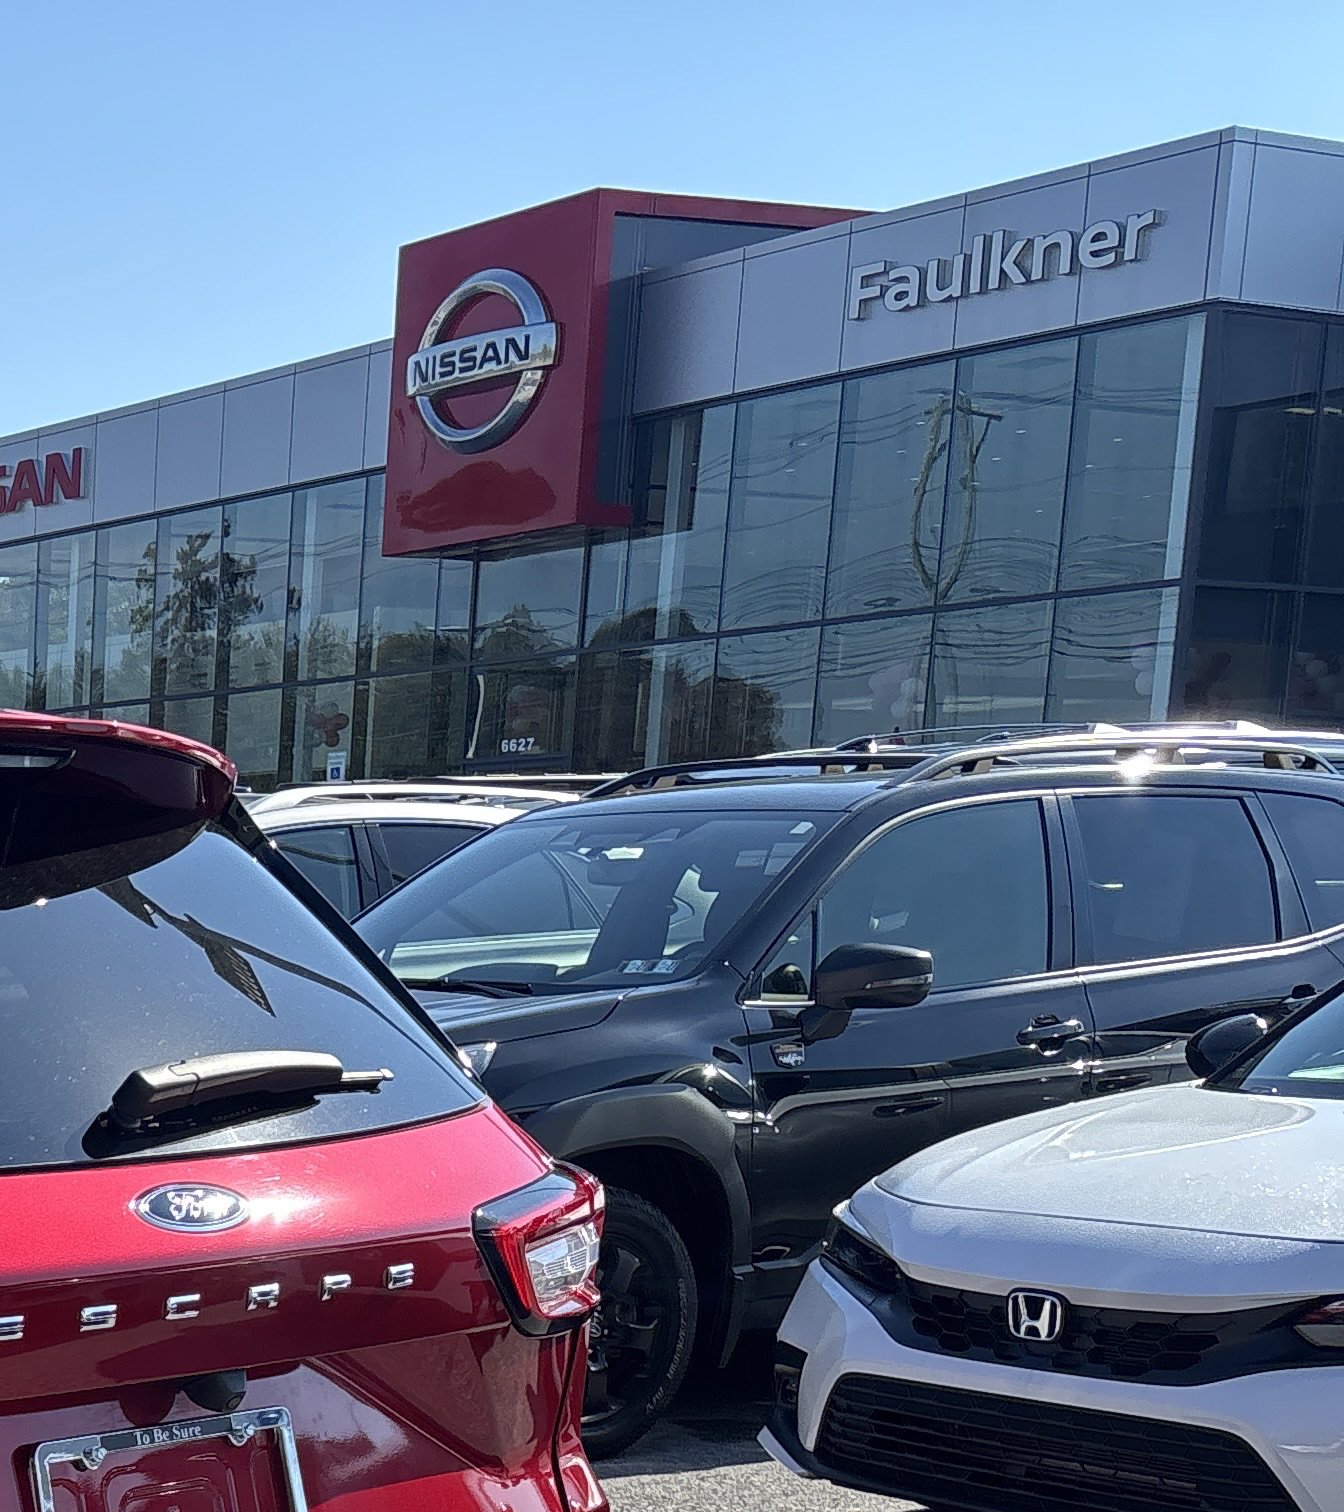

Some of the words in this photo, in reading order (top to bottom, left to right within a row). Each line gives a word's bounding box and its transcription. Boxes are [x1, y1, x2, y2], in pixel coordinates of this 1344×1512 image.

[847, 208, 1160, 321] Faulkner
[412, 333, 531, 388] NISSAN
[501, 736, 535, 753] 6627
[133, 1430, 151, 1446] To
[153, 1428, 170, 1442] Be
[172, 1425, 202, 1440] Sure
